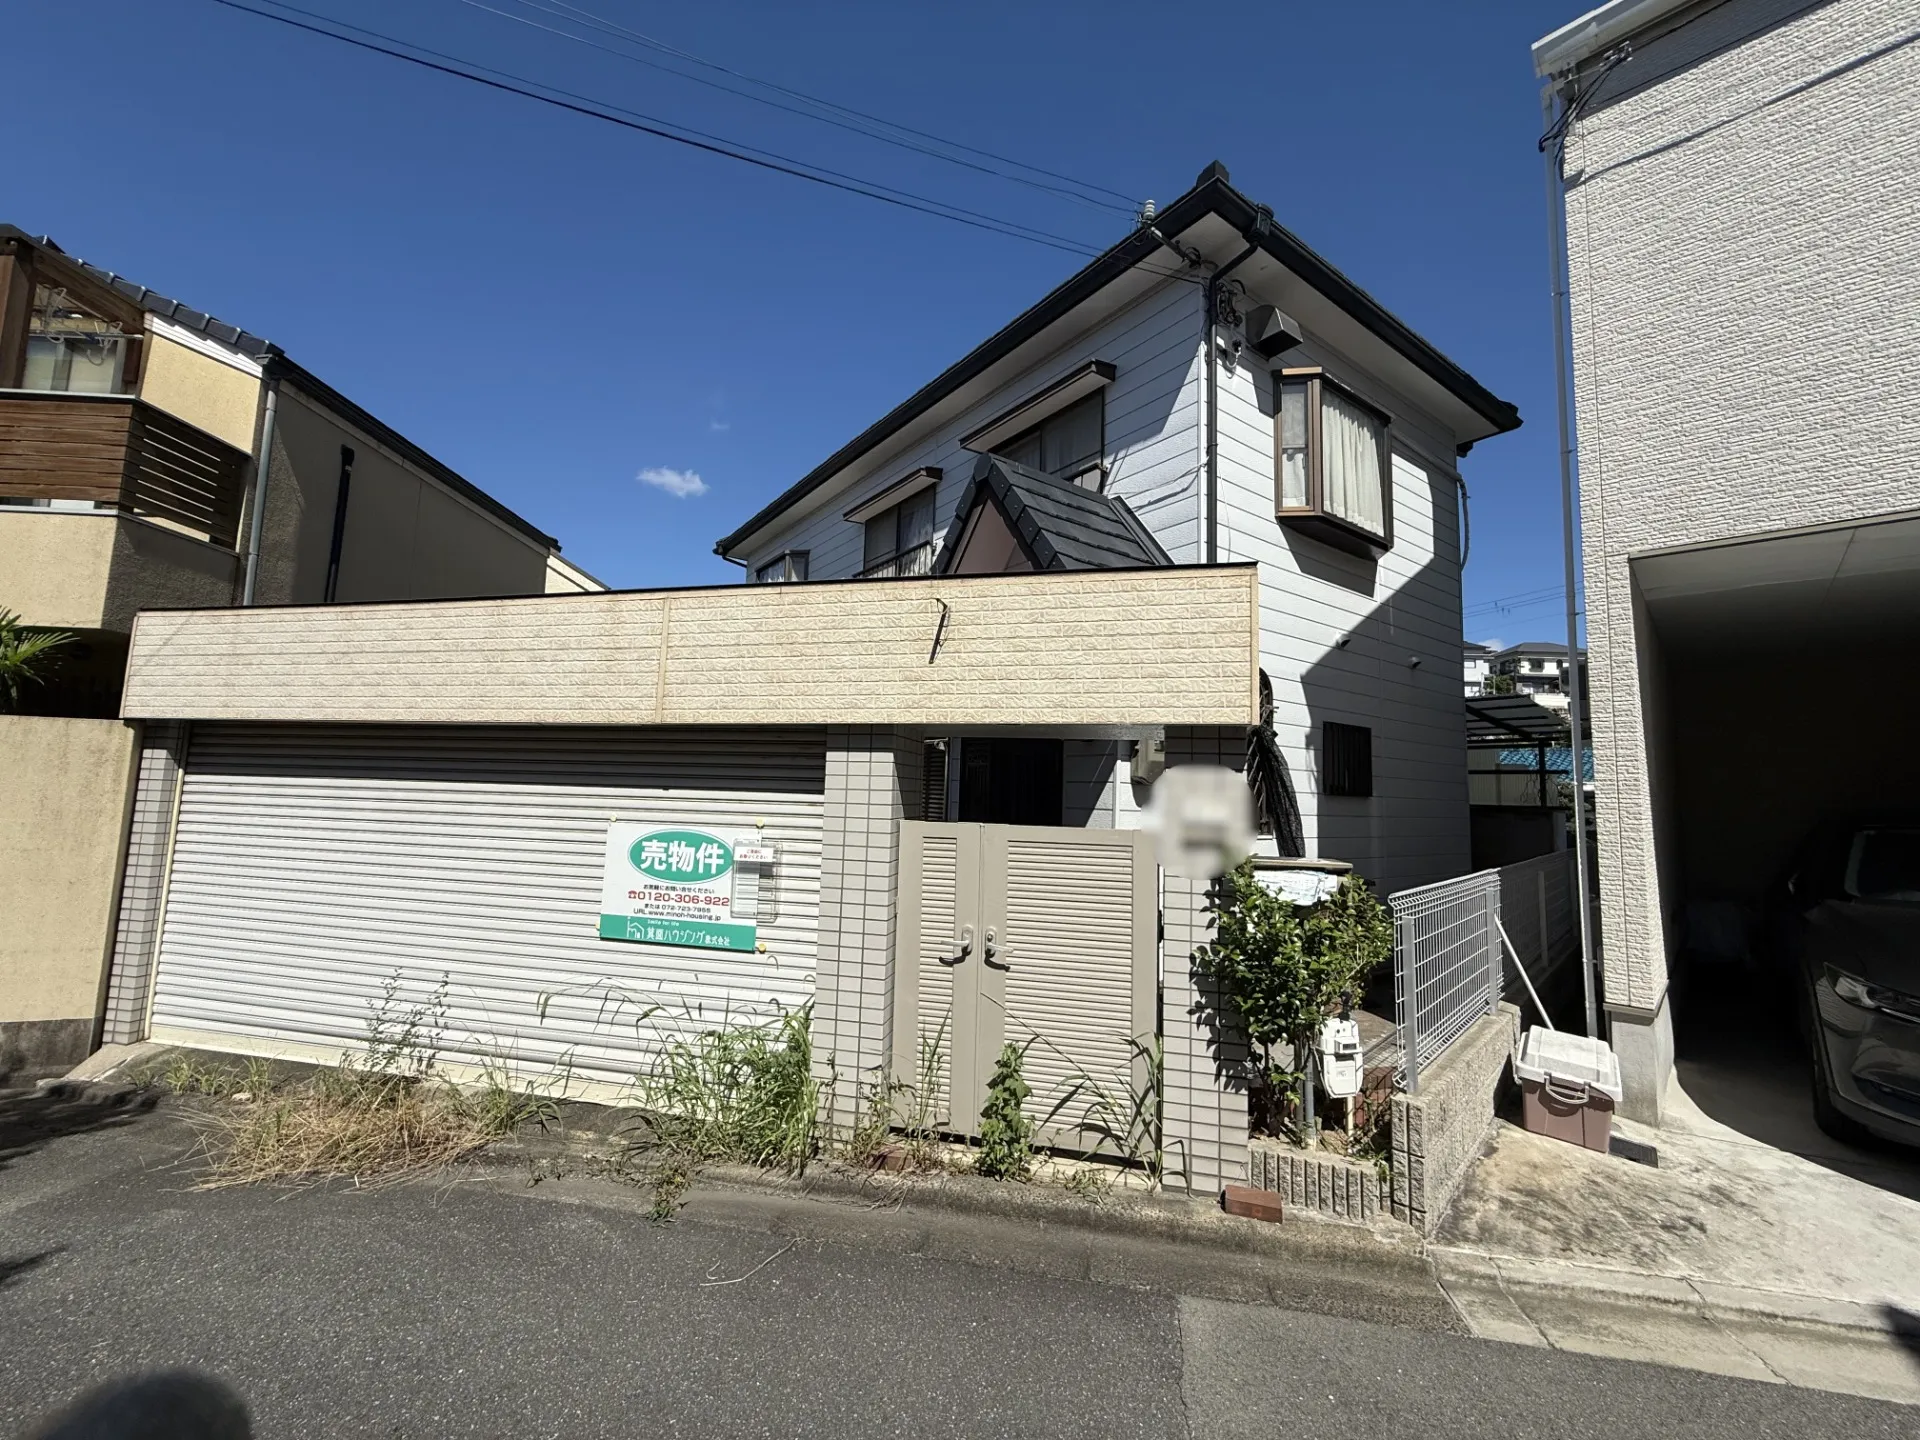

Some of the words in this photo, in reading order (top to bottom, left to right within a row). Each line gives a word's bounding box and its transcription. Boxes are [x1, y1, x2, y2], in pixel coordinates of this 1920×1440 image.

[640, 840, 725, 874] 売物件
[637, 891, 730, 906] 0120-306-922
